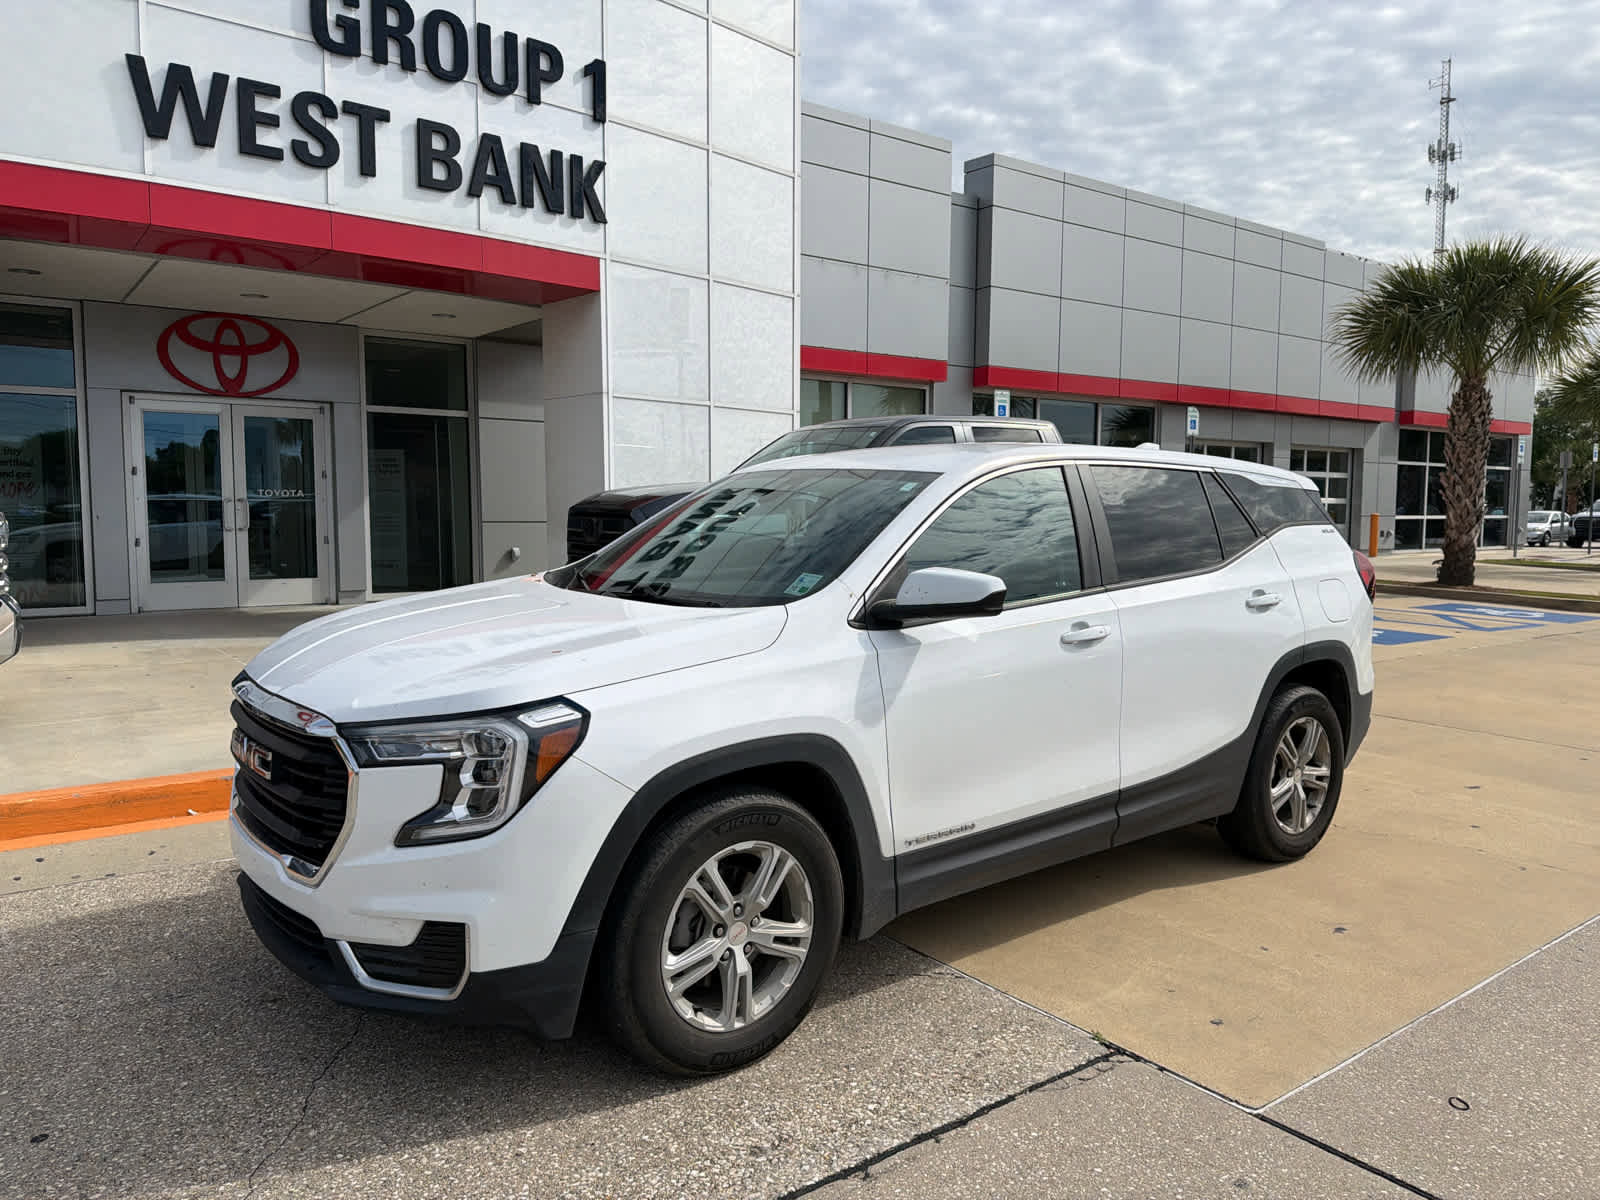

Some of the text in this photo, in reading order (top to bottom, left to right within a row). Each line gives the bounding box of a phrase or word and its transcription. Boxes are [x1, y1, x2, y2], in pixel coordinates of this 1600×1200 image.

[310, 0, 607, 123] GROUP 1
[125, 53, 608, 224] WEST BANK
[257, 488, 305, 498] TOYOTA
